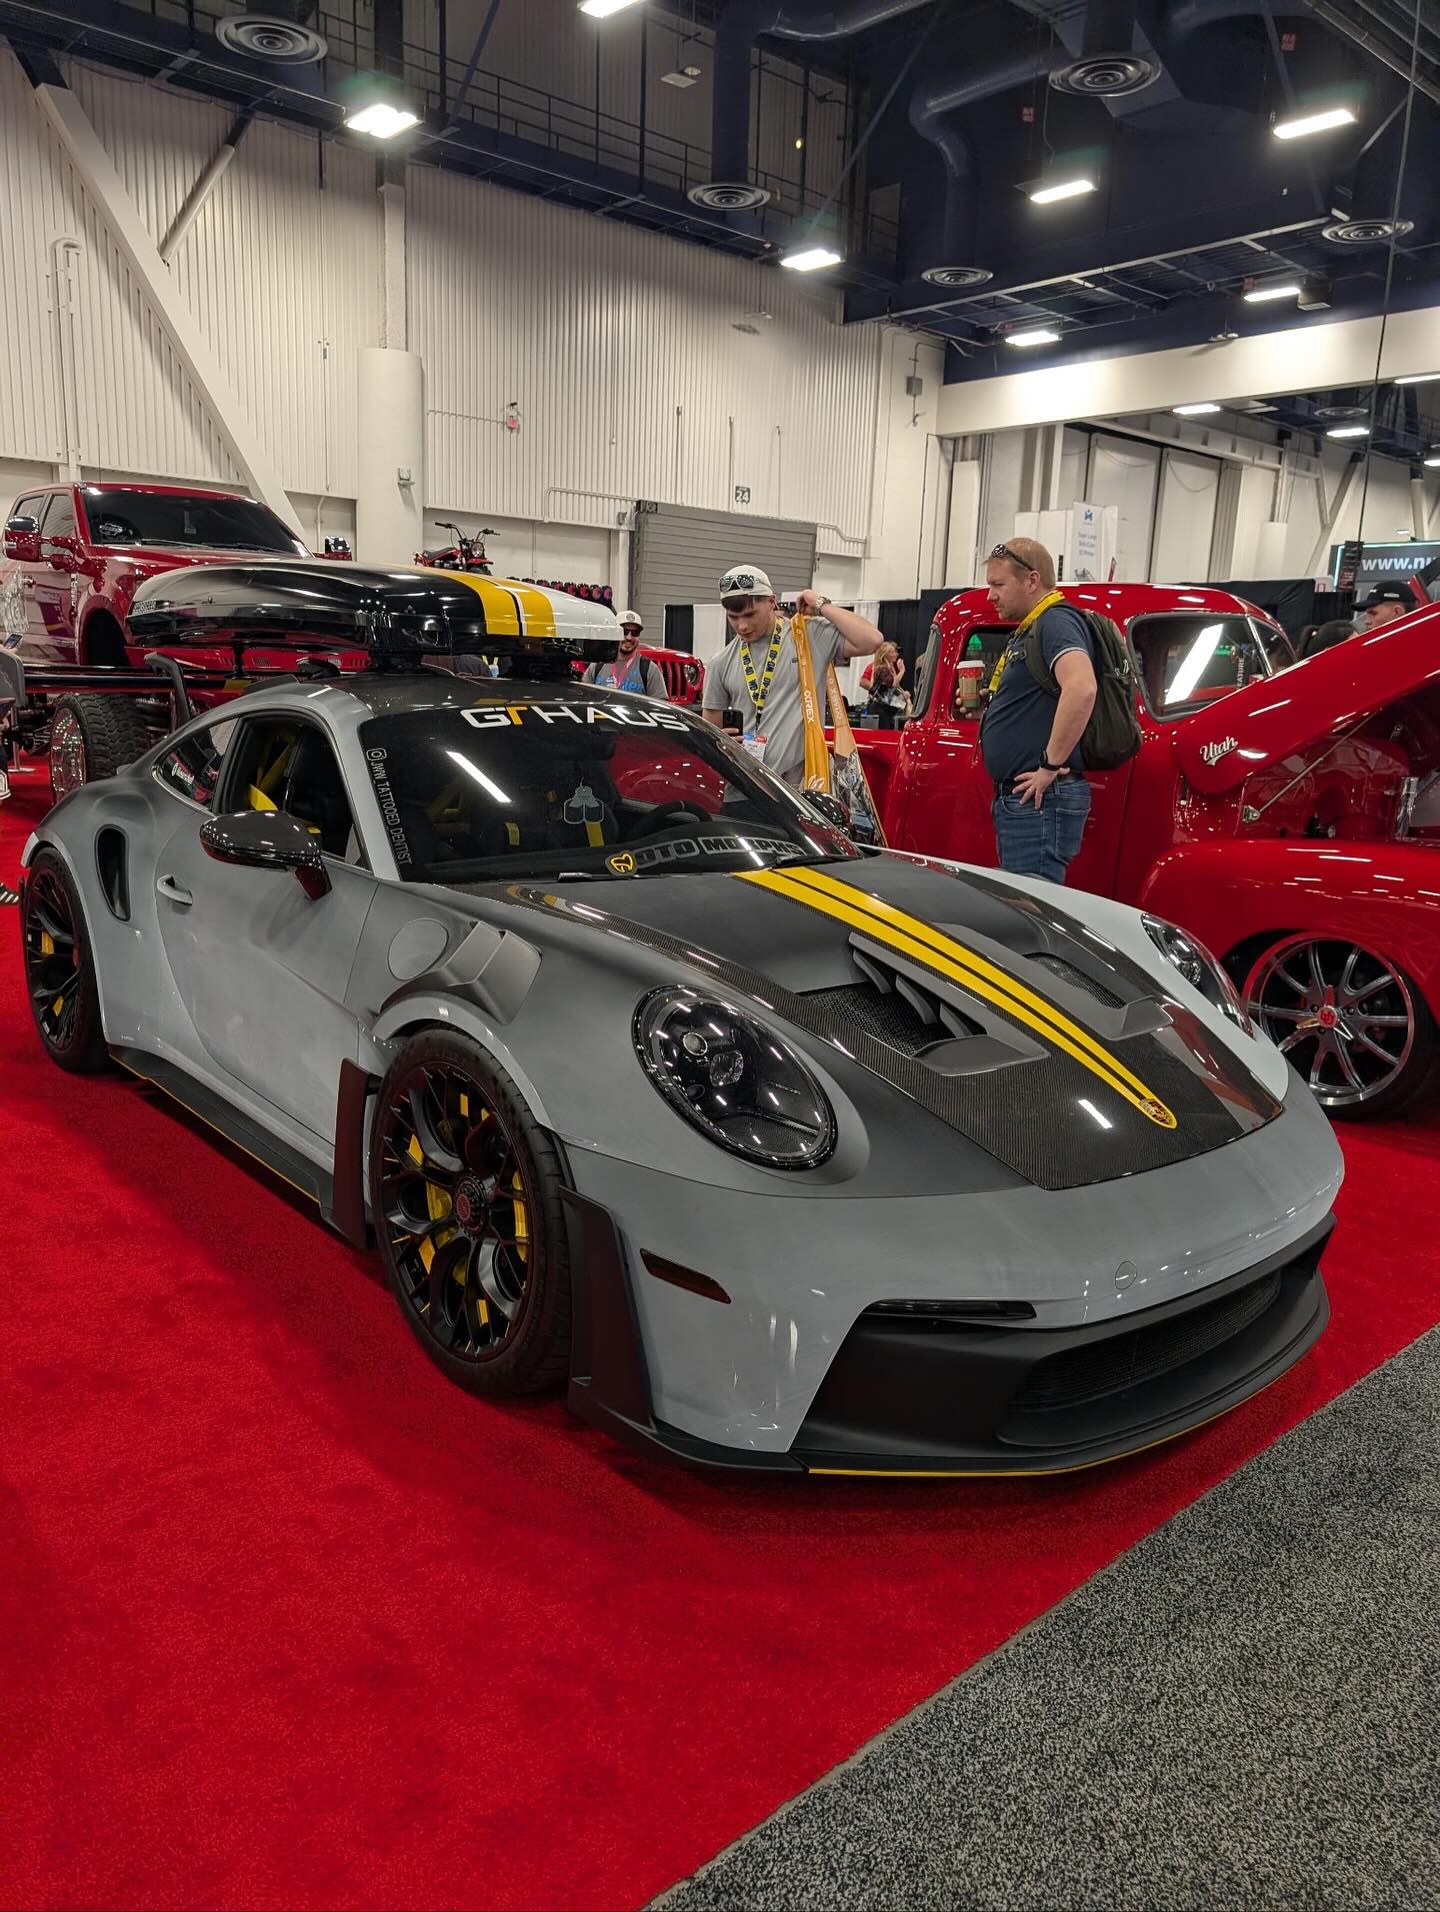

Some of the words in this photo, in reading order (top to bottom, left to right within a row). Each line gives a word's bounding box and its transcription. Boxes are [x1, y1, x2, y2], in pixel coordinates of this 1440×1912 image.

[736, 489, 749, 502] 24
[766, 650, 778, 672] WD-40
[1199, 736, 1239, 766] Utah
